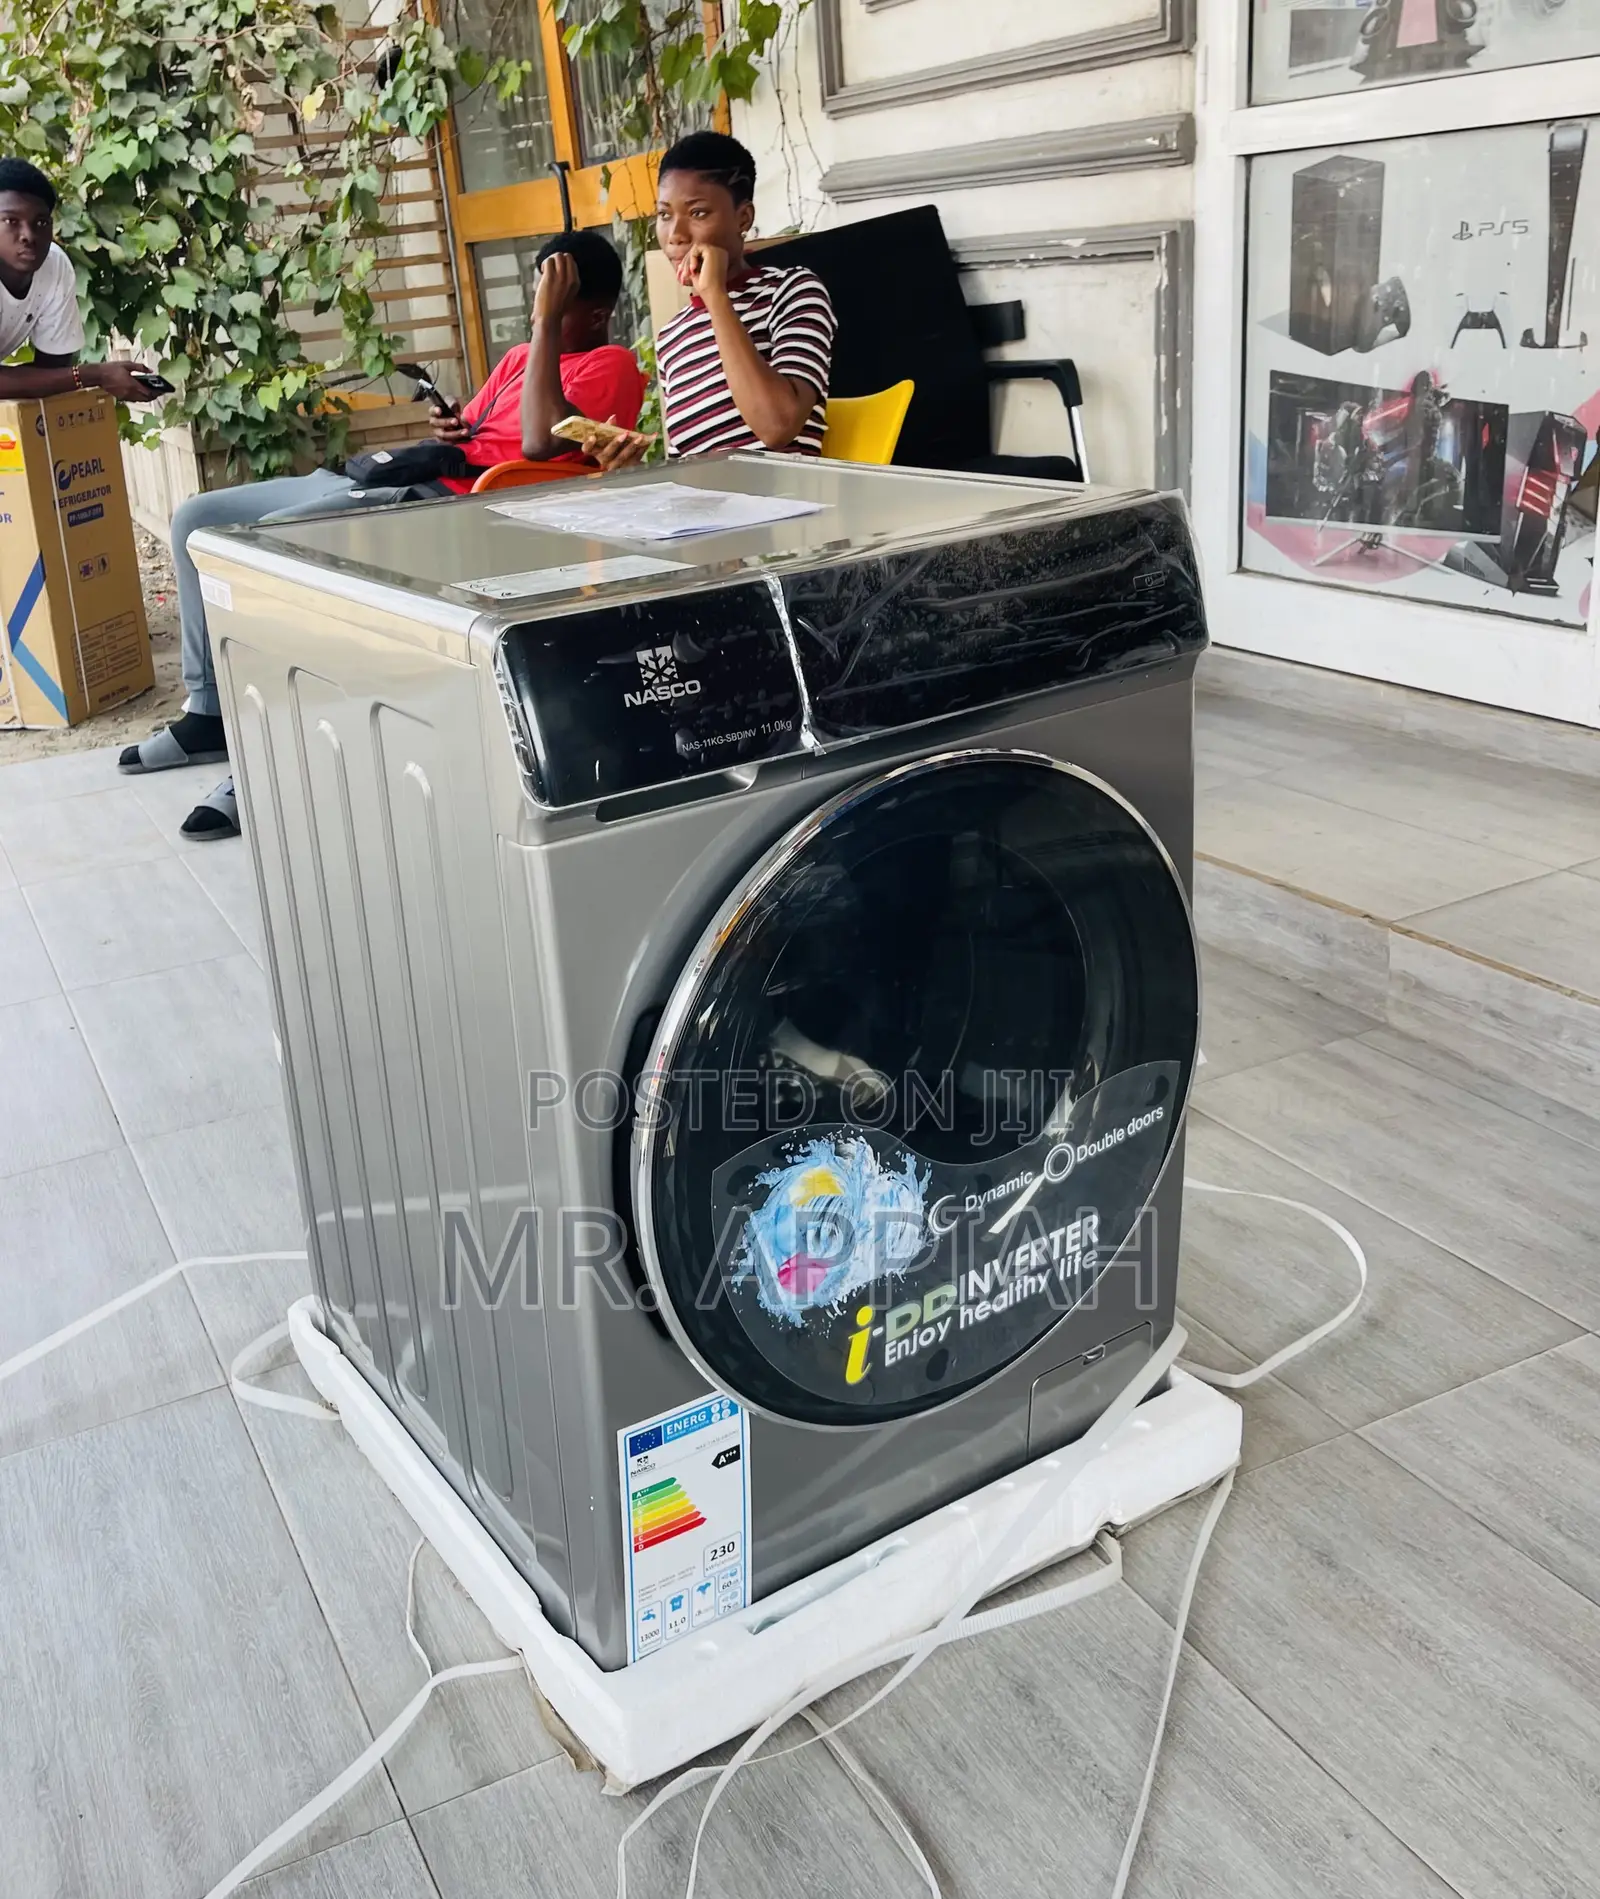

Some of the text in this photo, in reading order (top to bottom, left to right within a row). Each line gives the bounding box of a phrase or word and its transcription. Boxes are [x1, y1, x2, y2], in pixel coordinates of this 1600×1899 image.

[1478, 218, 1529, 237] PS5
[70, 457, 105, 480] PEARL
[622, 679, 702, 708] NASCO
[681, 719, 794, 752] NAS-11KG-SBDINV 11.0kg
[1075, 1106, 1165, 1164] Double doors
[964, 1170, 1034, 1213] Dynamic
[883, 1248, 1099, 1367] Enjoy healthy life
[666, 1411, 707, 1436] ENERG
[710, 1541, 736, 1562] 230
[640, 1628, 661, 1643] 13000
[668, 1616, 687, 1630] 11.0
